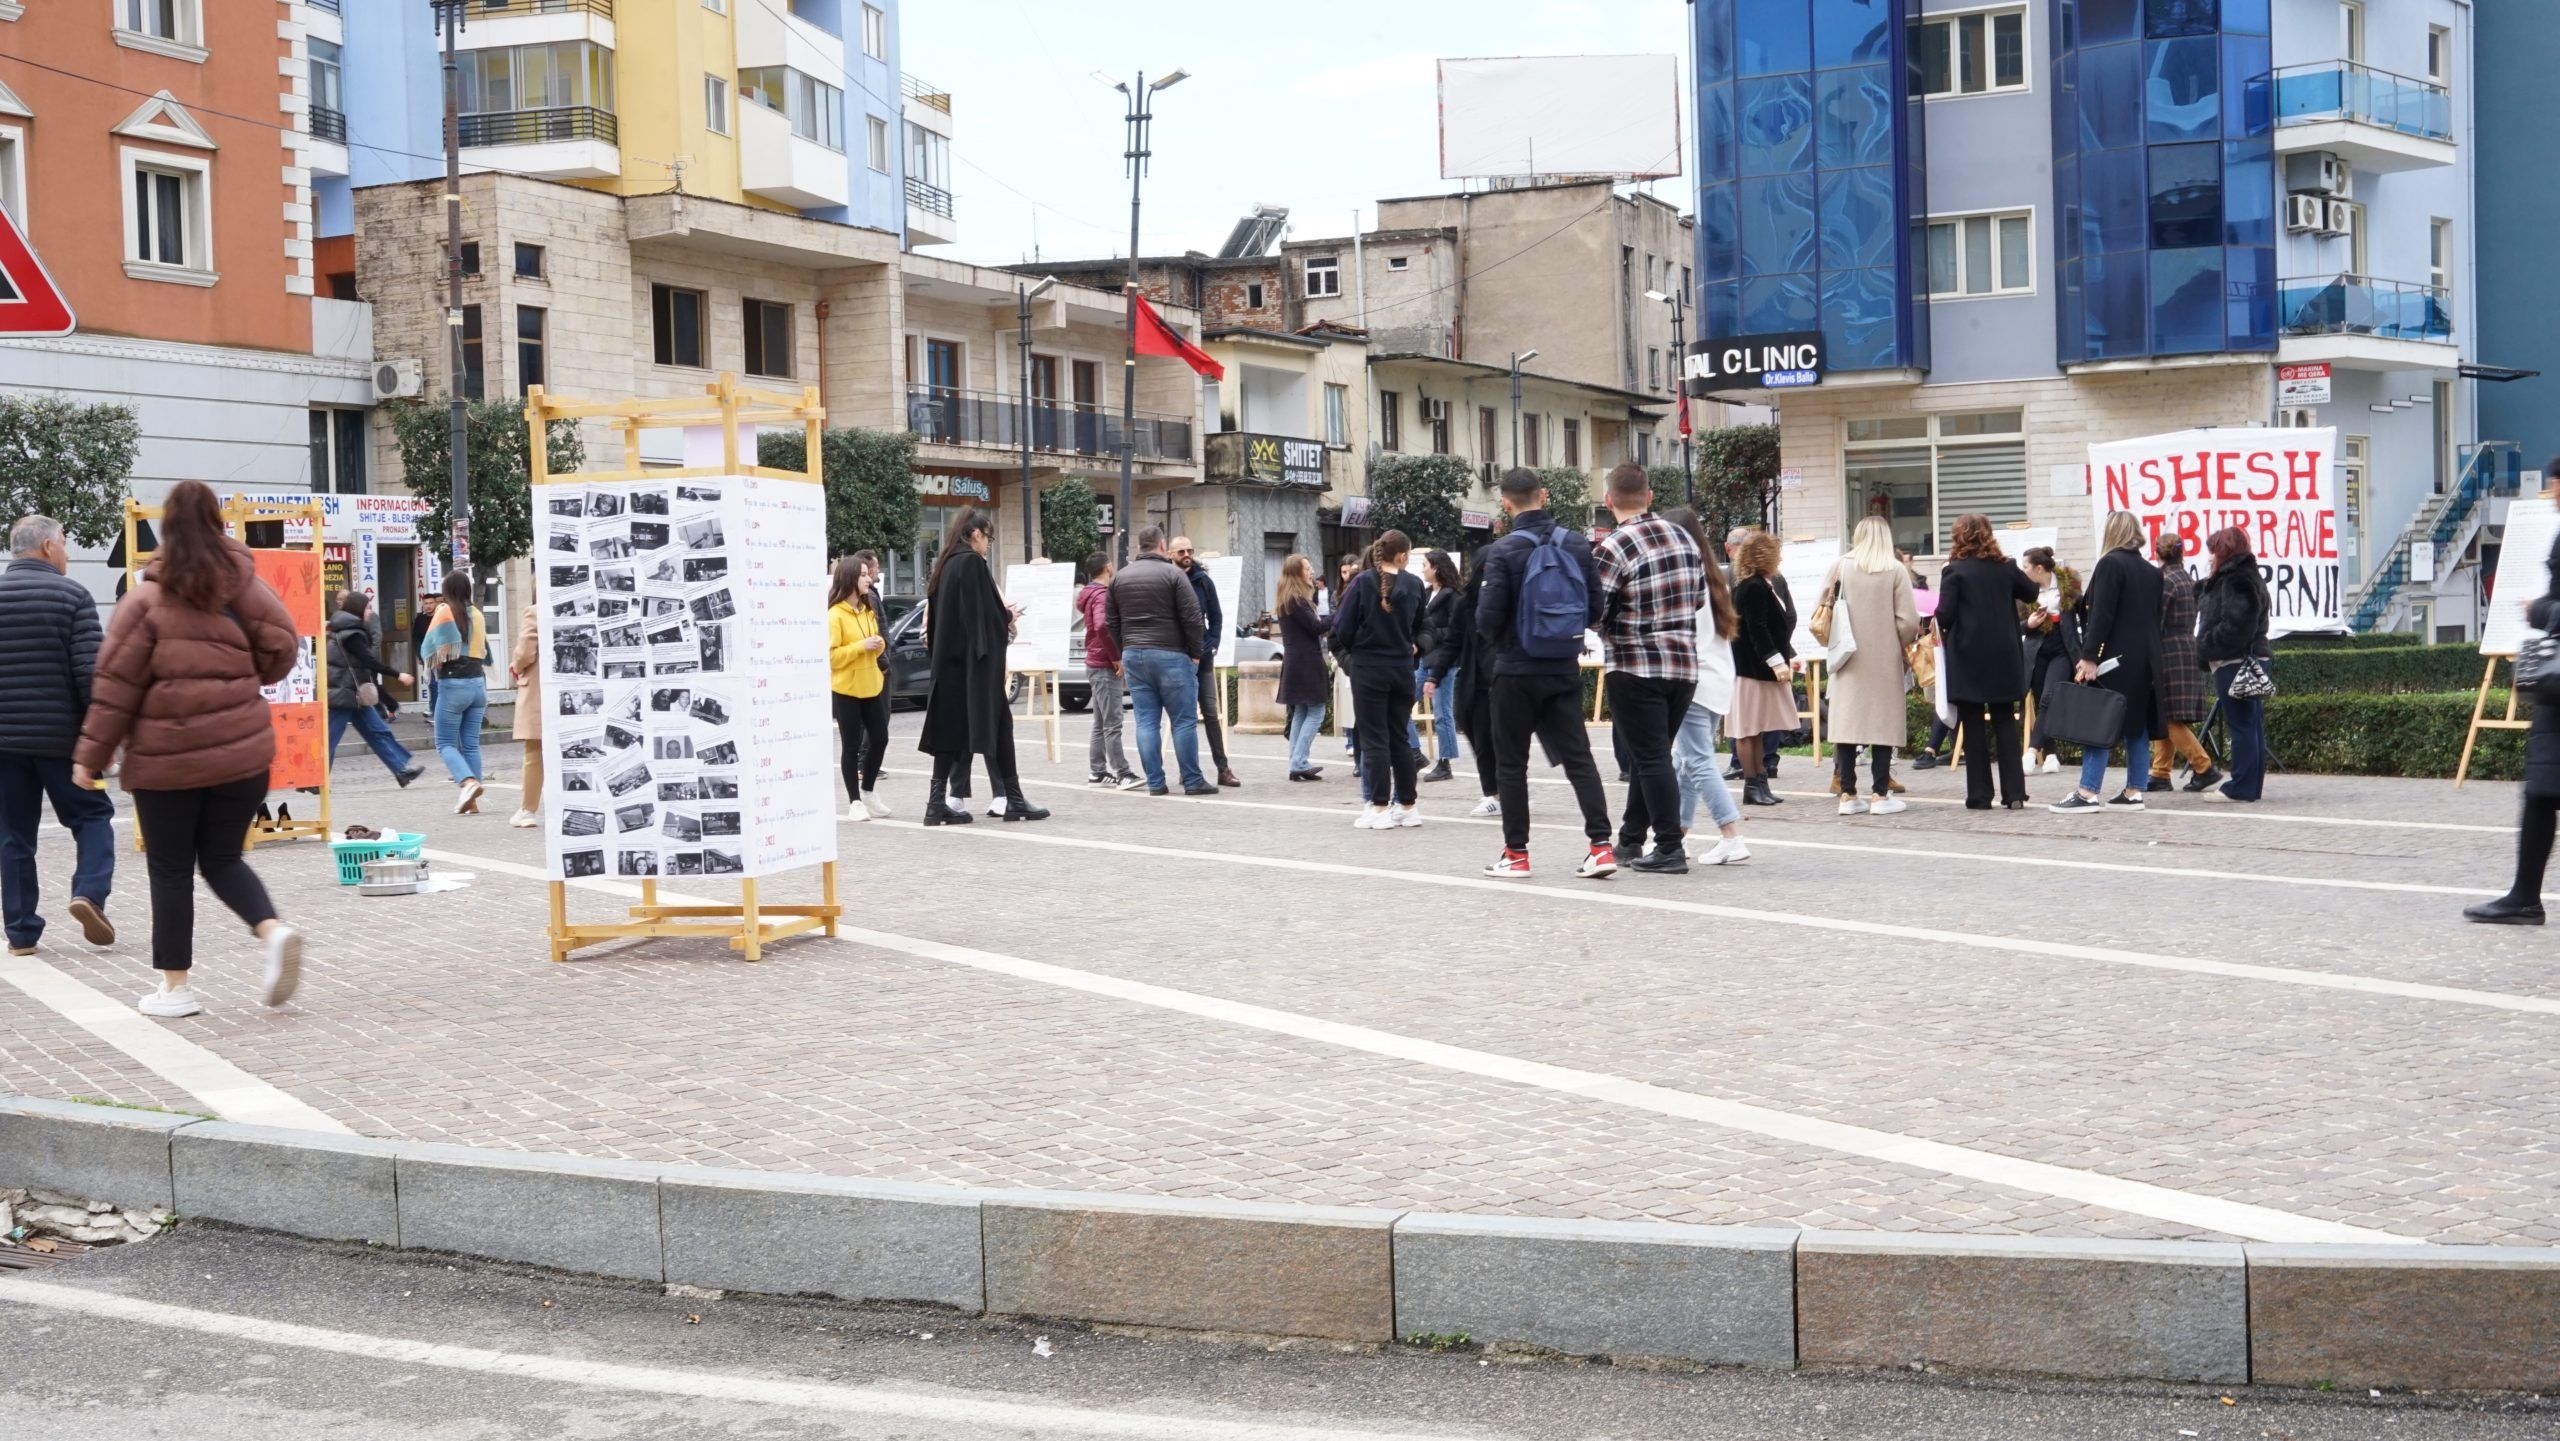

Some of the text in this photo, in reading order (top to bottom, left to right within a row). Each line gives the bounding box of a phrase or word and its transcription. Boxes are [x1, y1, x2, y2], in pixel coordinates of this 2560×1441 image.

[1723, 344, 1818, 374] CLINIC
[1283, 441, 1323, 468] SHITET
[2105, 451, 2321, 511] N'SHESH
[356, 498, 431, 512] INFORMACIONE
[359, 513, 386, 523] SHITJE
[324, 547, 348, 561] ALI
